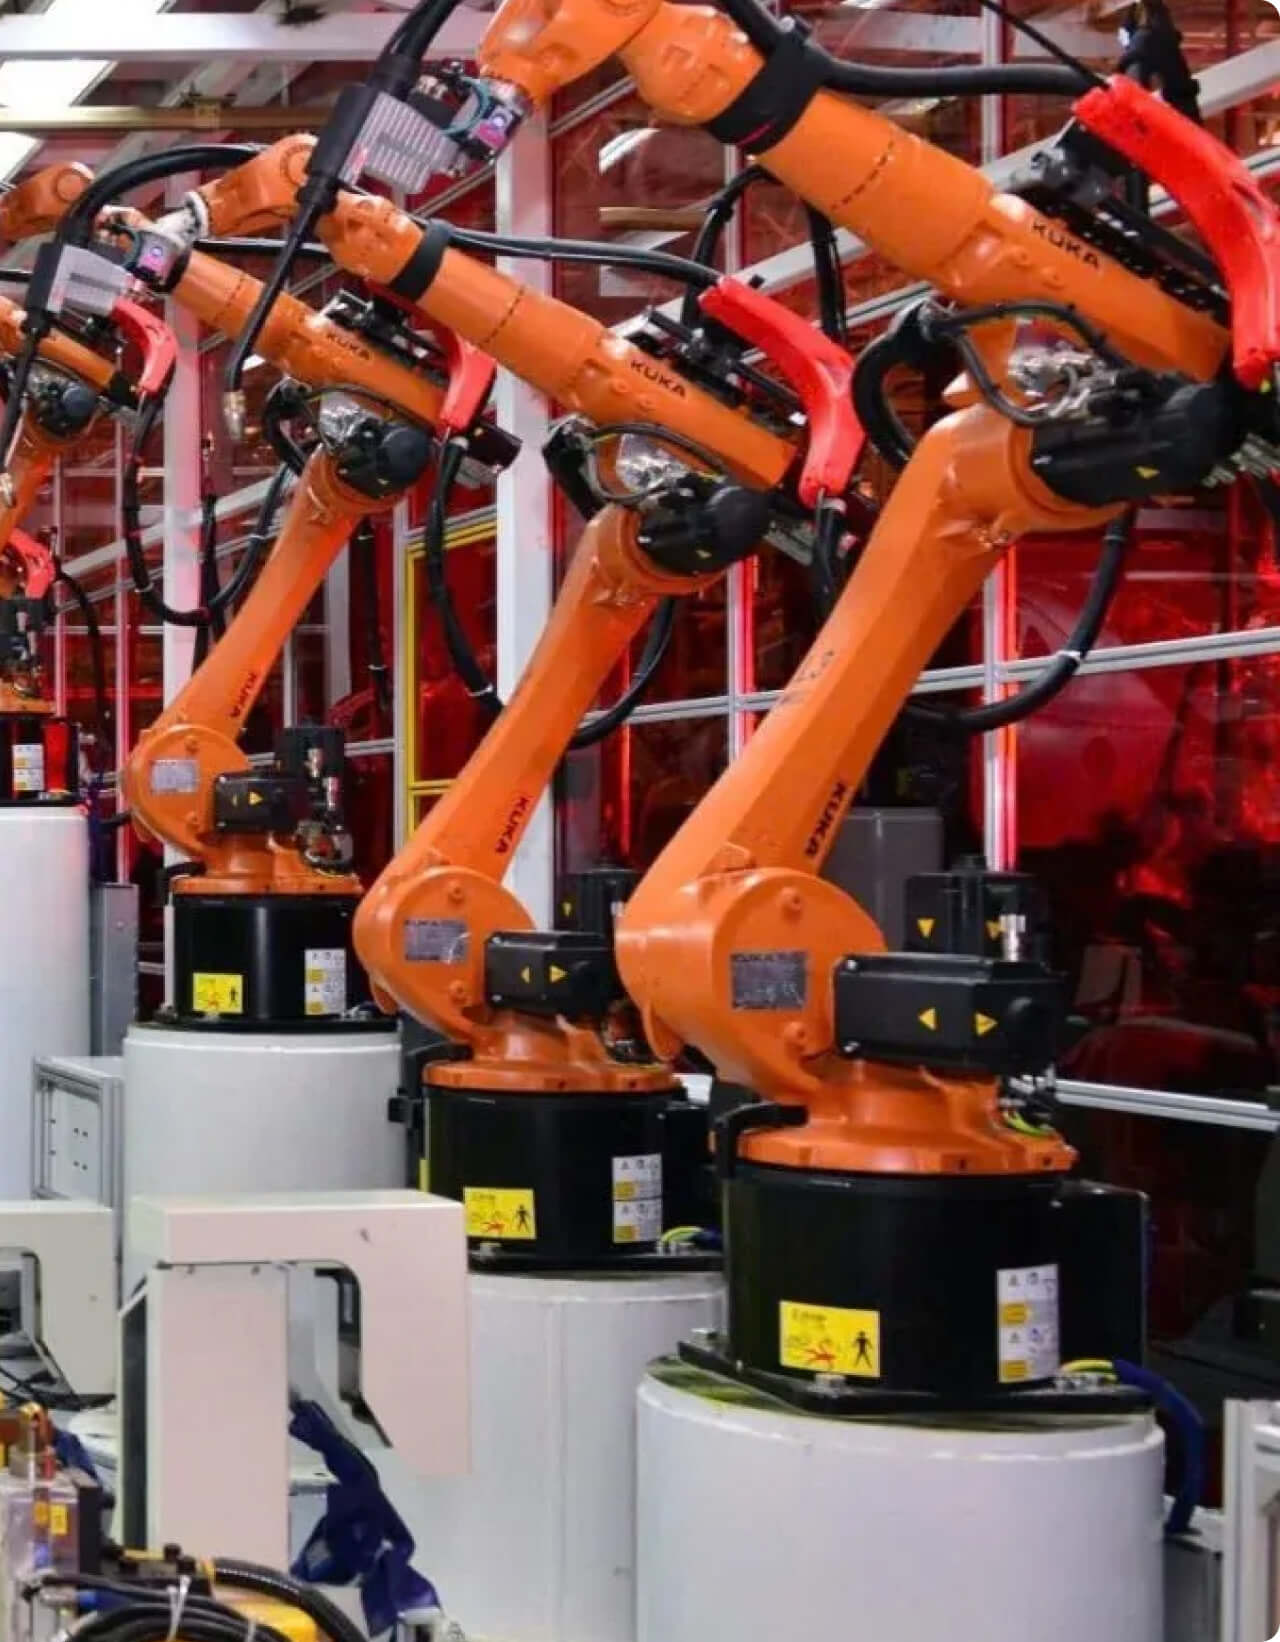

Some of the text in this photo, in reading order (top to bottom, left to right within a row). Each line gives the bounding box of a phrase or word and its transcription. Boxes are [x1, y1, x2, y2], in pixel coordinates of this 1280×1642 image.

[1032, 220, 1100, 271] KUKA
[326, 332, 370, 361] KUKA
[630, 359, 686, 397] KUKA
[496, 796, 531, 854] KUKA
[805, 781, 846, 857] KUKA
